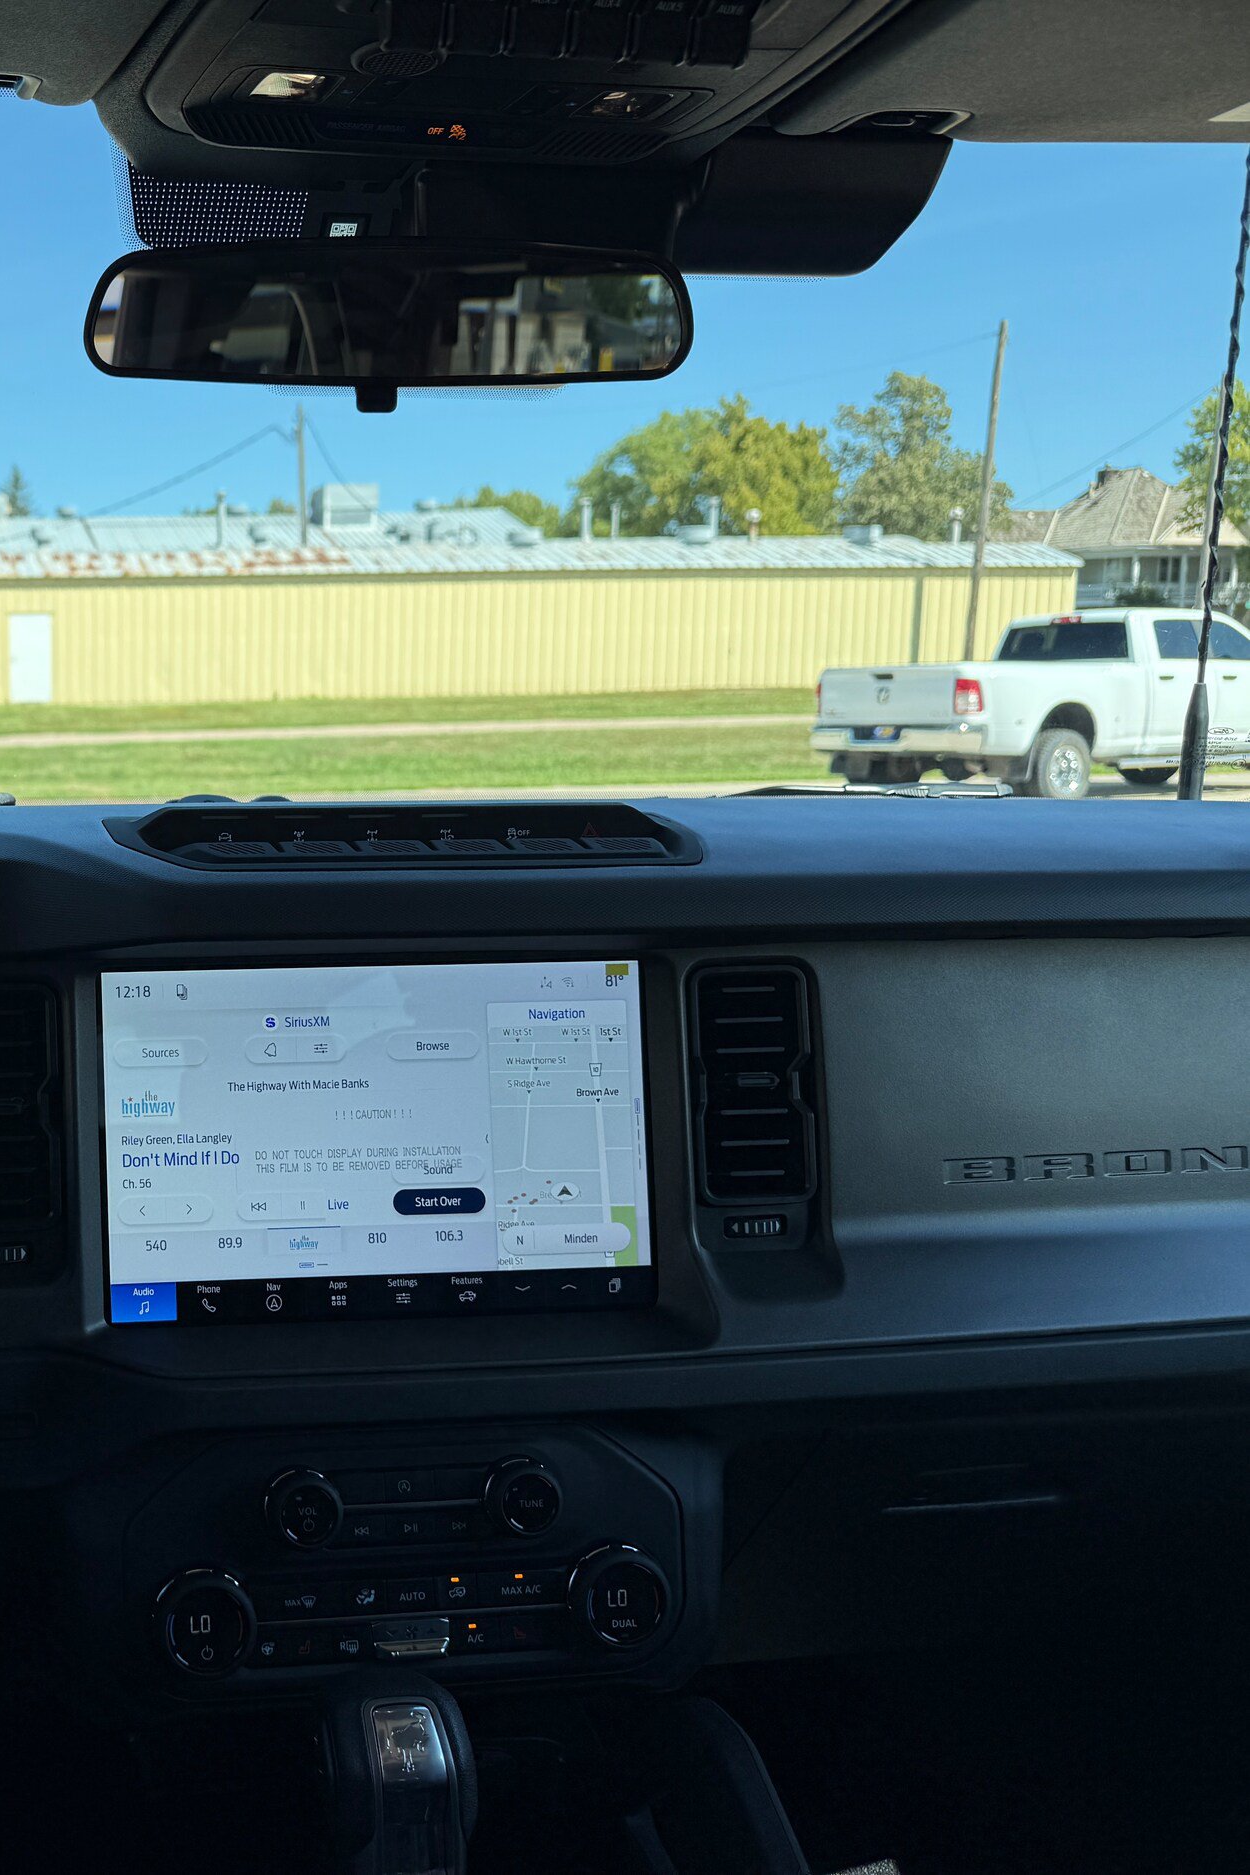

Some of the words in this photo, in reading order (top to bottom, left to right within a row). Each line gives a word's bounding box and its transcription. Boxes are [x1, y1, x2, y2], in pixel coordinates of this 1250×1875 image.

[427, 127, 445, 135] OFF
[115, 985, 151, 999] 12:18
[528, 1009, 586, 1021] Navigation
[284, 1016, 330, 1028] SiriusXM
[612, 1028, 621, 1036] St
[416, 1041, 449, 1051] Browse
[141, 1048, 180, 1058] Sources
[227, 1082, 245, 1092] The
[247, 1081, 286, 1093] Highway
[288, 1080, 311, 1091] With
[312, 1080, 340, 1090] Macie
[341, 1078, 370, 1089] Banks
[513, 1081, 535, 1089] Ridge
[144, 1090, 158, 1101] the
[576, 1089, 602, 1097] Brown
[603, 1088, 619, 1096] Ave
[121, 1097, 175, 1117] highway
[121, 1135, 144, 1147] Riley
[145, 1135, 175, 1146] Green,
[177, 1134, 194, 1144] Ella
[196, 1133, 233, 1146] Langley
[255, 1150, 268, 1161] DO
[272, 1150, 289, 1160] NOT
[294, 1149, 323, 1159] TOUCH
[327, 1148, 362, 1159] DISPLAY
[366, 1147, 398, 1158] DURING
[403, 1146, 461, 1157] INSTALLATION
[122, 1152, 160, 1168] Don't
[164, 1152, 198, 1166] Mind
[201, 1151, 212, 1165] If
[221, 1151, 240, 1165] Do
[257, 1163, 275, 1173] THIS
[279, 1162, 299, 1173] FILM
[303, 1162, 312, 1172] IS
[317, 1162, 328, 1172] TO
[333, 1161, 344, 1171] BE
[349, 1160, 391, 1171] REMOVED
[396, 1159, 428, 1170] BEFORE
[434, 1158, 463, 1169] USAGE
[423, 1165, 453, 1175] Sound
[122, 1179, 137, 1190] Ch.
[139, 1178, 152, 1189] 56
[327, 1199, 349, 1210] Live
[415, 1197, 438, 1207] Start
[440, 1196, 461, 1206] Over
[368, 1232, 387, 1244] 810
[435, 1230, 463, 1242] 106.3
[516, 1236, 524, 1245] N
[564, 1233, 598, 1244] Minden
[145, 1239, 167, 1251] 540
[218, 1237, 242, 1249] 89.9
[329, 1280, 348, 1290] Apps
[387, 1278, 418, 1288] Settings
[451, 1276, 482, 1285] Features
[133, 1287, 155, 1296] Audio
[197, 1285, 221, 1294] Phone
[266, 1283, 281, 1291] Nav
[519, 1499, 545, 1508] TUNE
[298, 1507, 317, 1516] VOL
[501, 1586, 523, 1595] MAX
[524, 1584, 542, 1595] A/C
[399, 1591, 426, 1602] AUTO
[284, 1599, 302, 1608] MAX
[611, 1618, 637, 1629] DUAL
[467, 1633, 484, 1644] A/C
